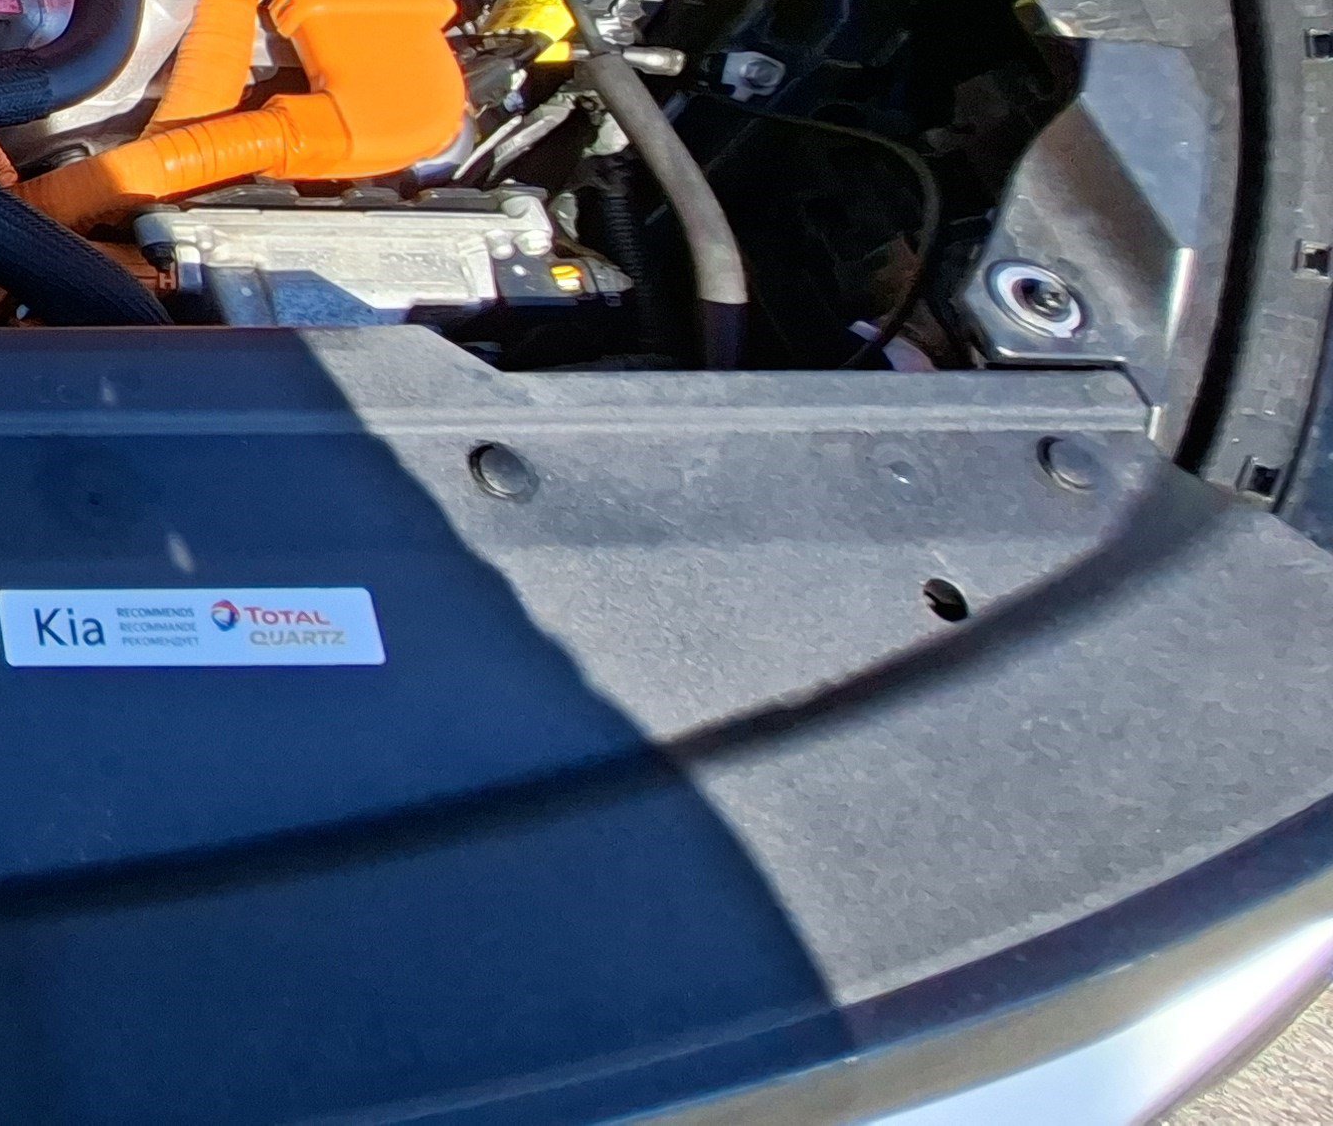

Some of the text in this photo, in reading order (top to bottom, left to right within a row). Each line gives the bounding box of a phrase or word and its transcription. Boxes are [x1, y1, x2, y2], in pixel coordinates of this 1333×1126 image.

[116, 607, 195, 617] RECOMMENDS
[243, 606, 330, 625] TOTAL
[34, 607, 106, 646] Kia
[249, 630, 346, 646] QUARTZ
